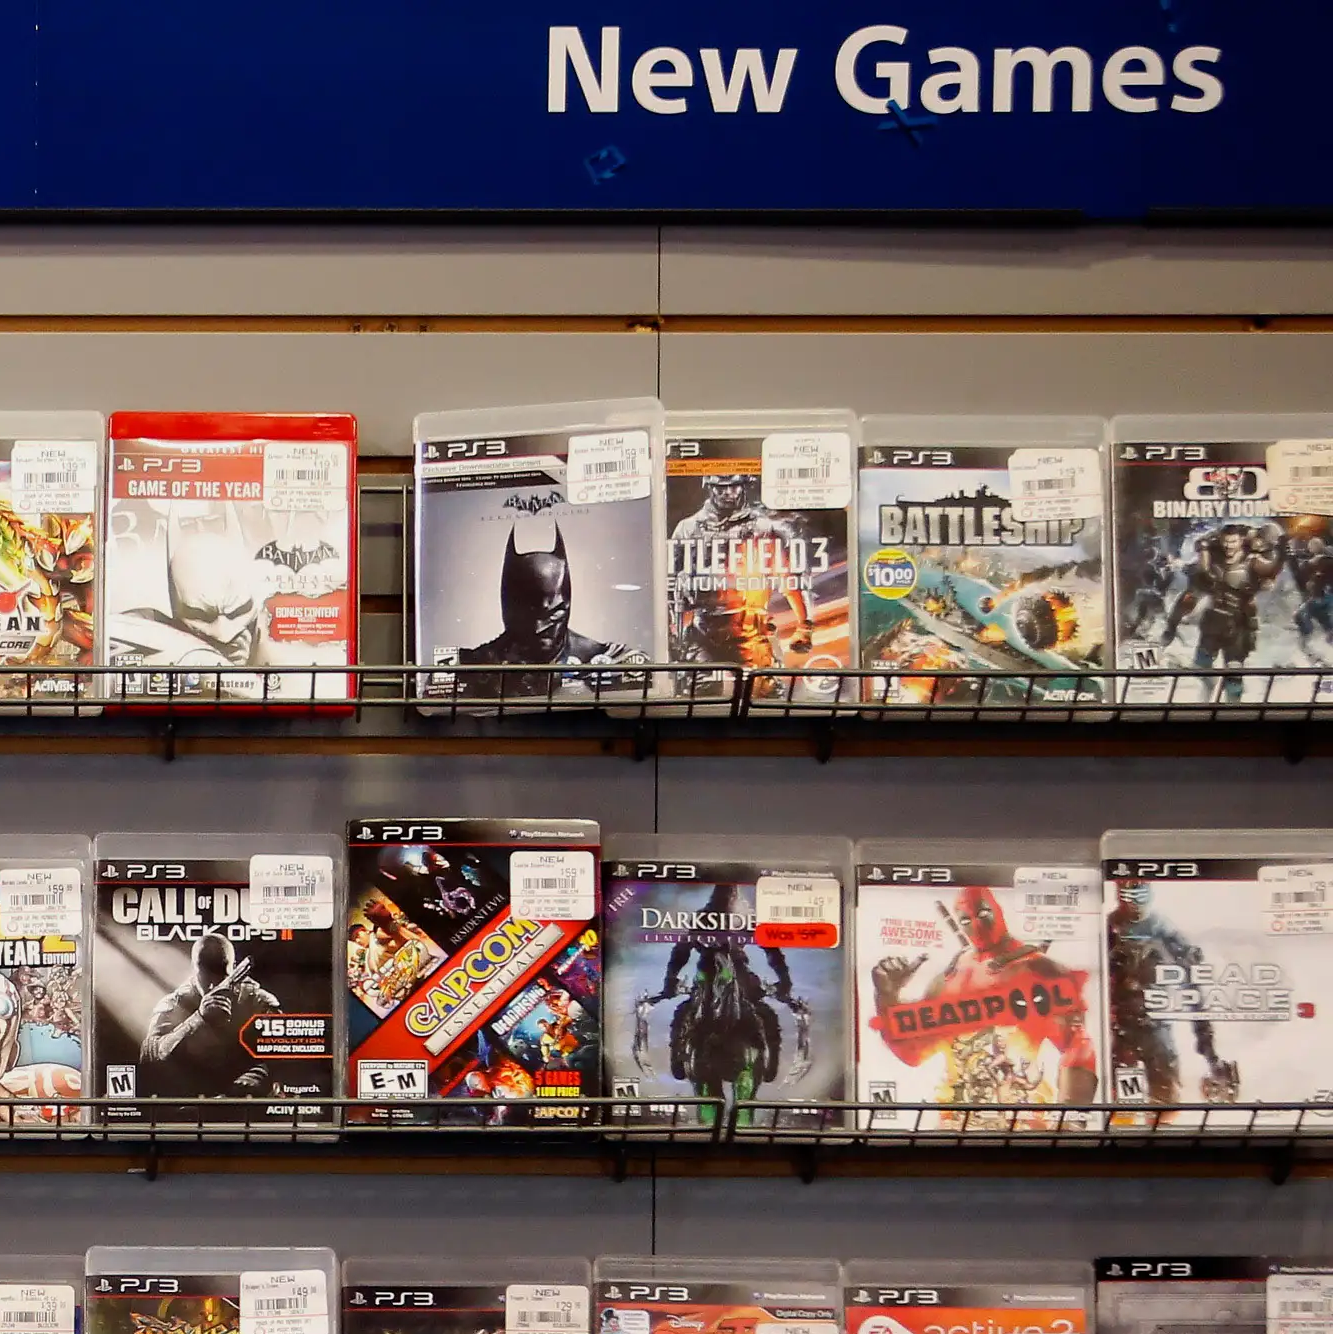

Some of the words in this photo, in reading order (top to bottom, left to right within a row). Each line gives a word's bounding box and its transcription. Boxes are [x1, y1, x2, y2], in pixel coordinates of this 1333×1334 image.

[547, 25, 799, 115] New
[834, 24, 1223, 115] Games
[128, 480, 167, 497] GAME
[171, 481, 190, 497] OF
[193, 481, 221, 498] THE
[224, 482, 261, 498] YEAR
[1153, 501, 1224, 518] BINARY
[112, 887, 197, 924] CALL
[198, 895, 212, 910] OF
[136, 924, 208, 941] BLACK
[227, 925, 277, 941] OPS
[42, 953, 77, 965] EDITION
[406, 914, 543, 1037] CAPCOM
[1154, 963, 1283, 987] DEAD
[443, 938, 547, 1038] ESSENTIALS
[1143, 989, 1291, 1013] SPACE
[254, 1018, 285, 1037] $15
[286, 1020, 325, 1028] BONUS
[286, 1028, 325, 1037] CONTENT
